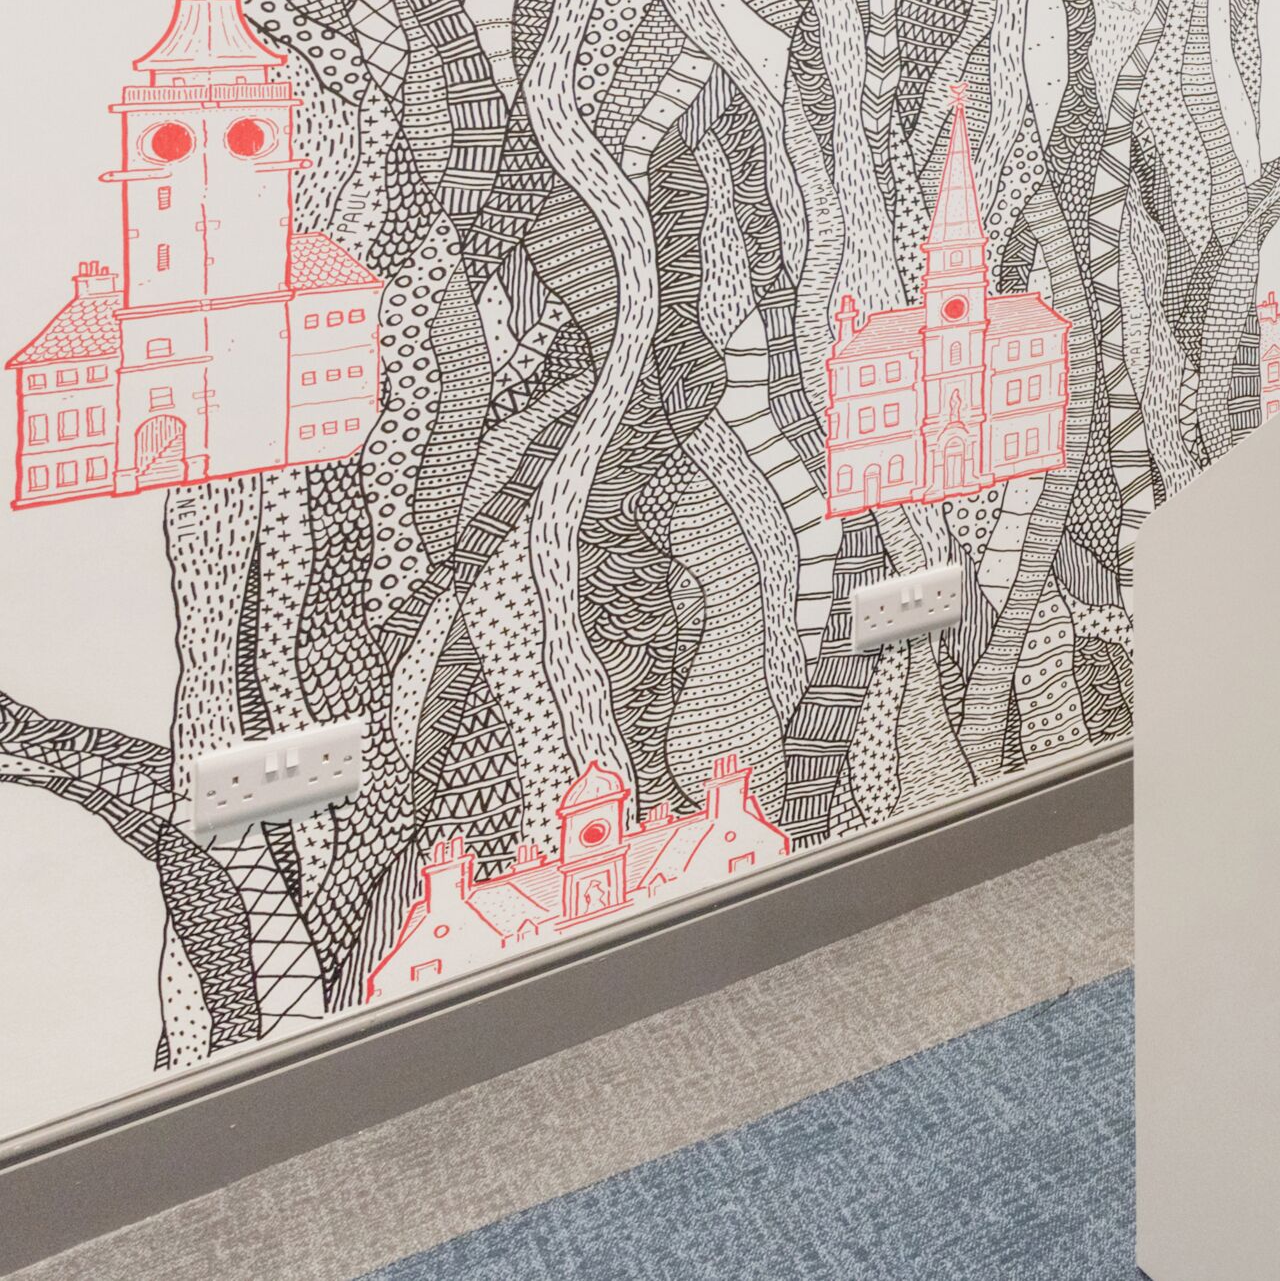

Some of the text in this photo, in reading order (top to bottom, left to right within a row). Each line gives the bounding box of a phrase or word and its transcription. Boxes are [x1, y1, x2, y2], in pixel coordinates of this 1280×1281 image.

[338, 189, 370, 235] PAUL
[814, 183, 833, 237] MARIE
[1129, 312, 1143, 369] MAISIE
[175, 497, 197, 543] NEIL
